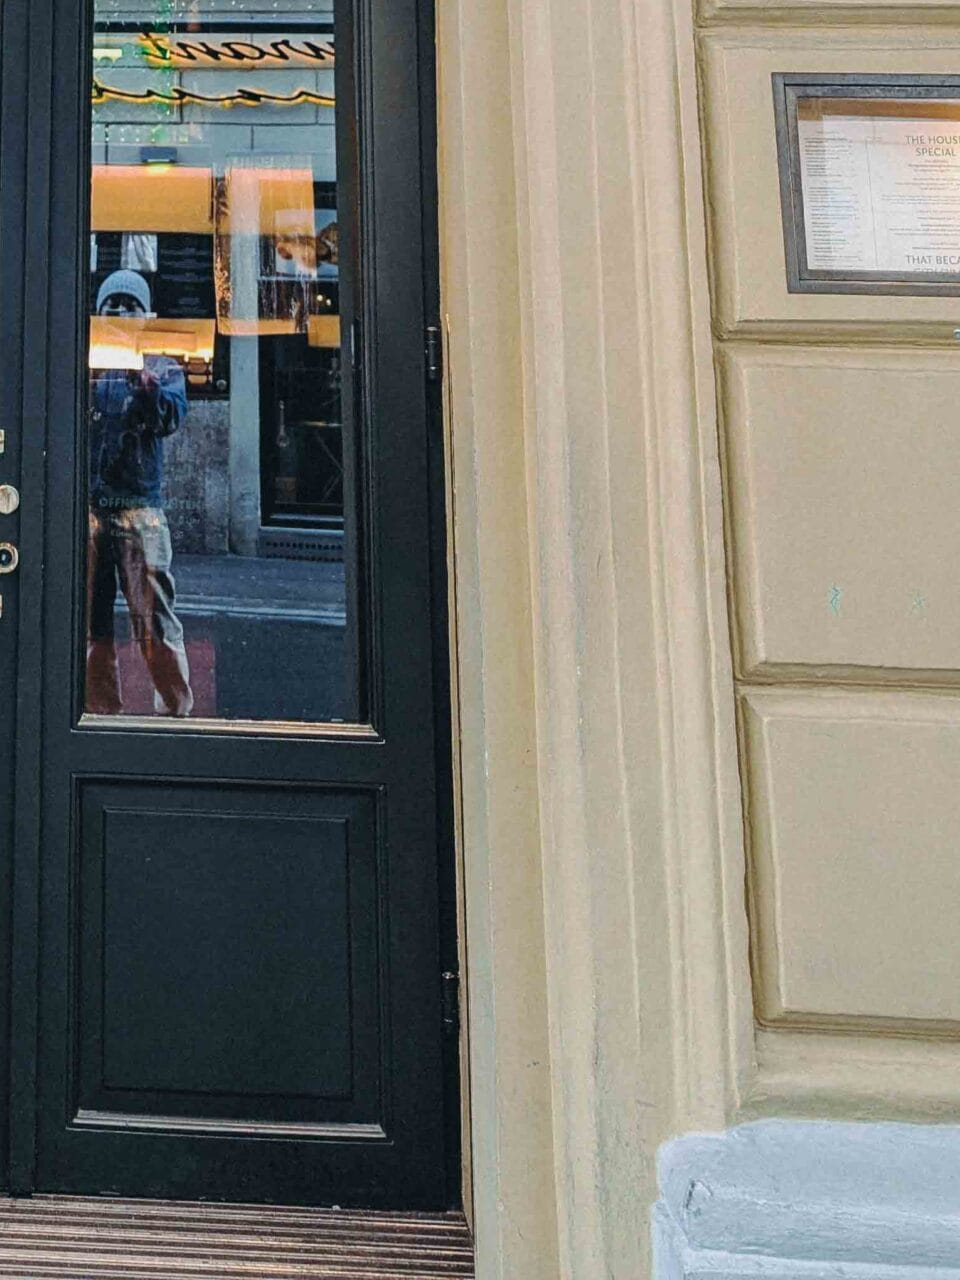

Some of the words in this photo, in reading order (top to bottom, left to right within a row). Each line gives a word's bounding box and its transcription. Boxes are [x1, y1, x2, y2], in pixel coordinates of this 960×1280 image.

[906, 135, 926, 145] THE
[915, 147, 957, 157] SPECIAL
[906, 254, 932, 265] THAT
